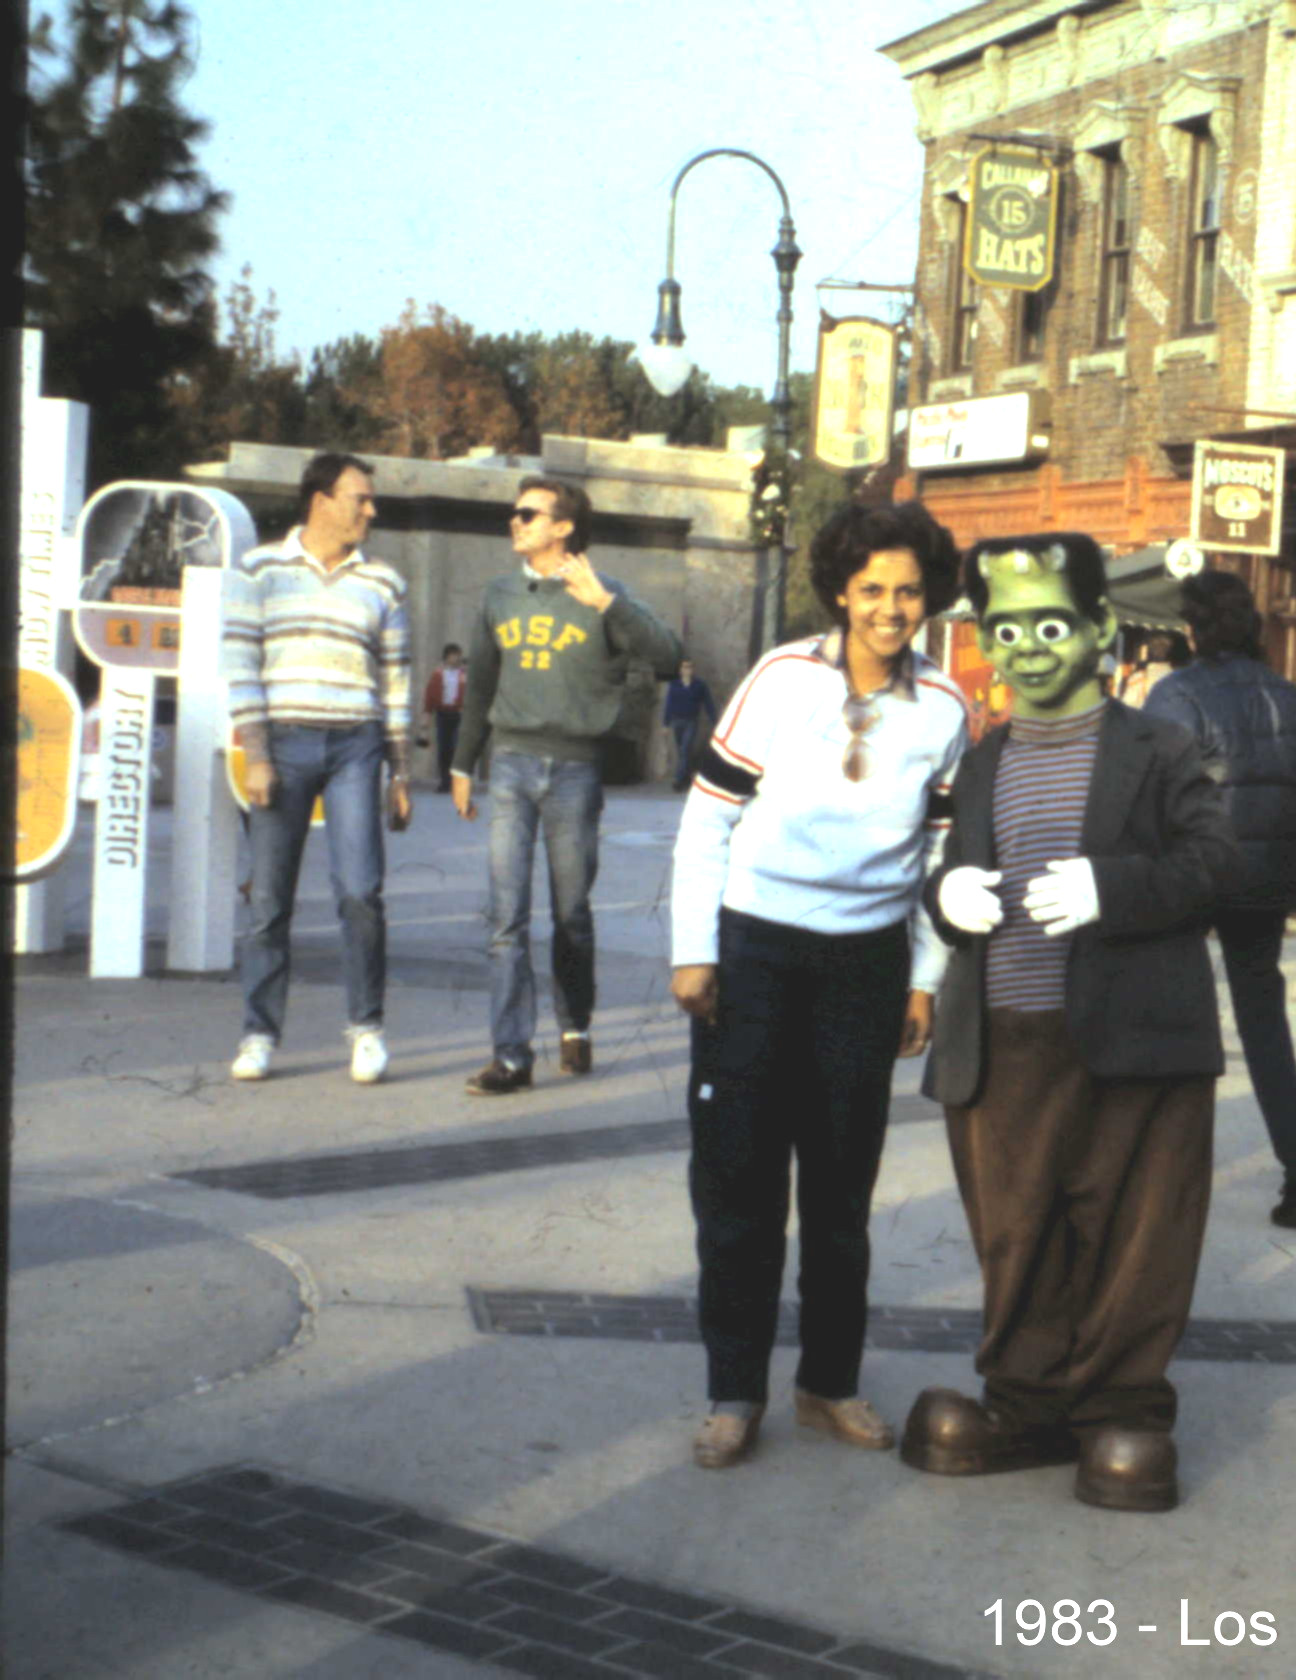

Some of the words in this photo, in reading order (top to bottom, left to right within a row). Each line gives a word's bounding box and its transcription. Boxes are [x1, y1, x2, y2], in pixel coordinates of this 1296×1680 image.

[1001, 199, 1027, 226] 15
[975, 226, 1046, 275] HATS
[496, 614, 587, 652] USF
[104, 688, 146, 869] DIRECTORY
